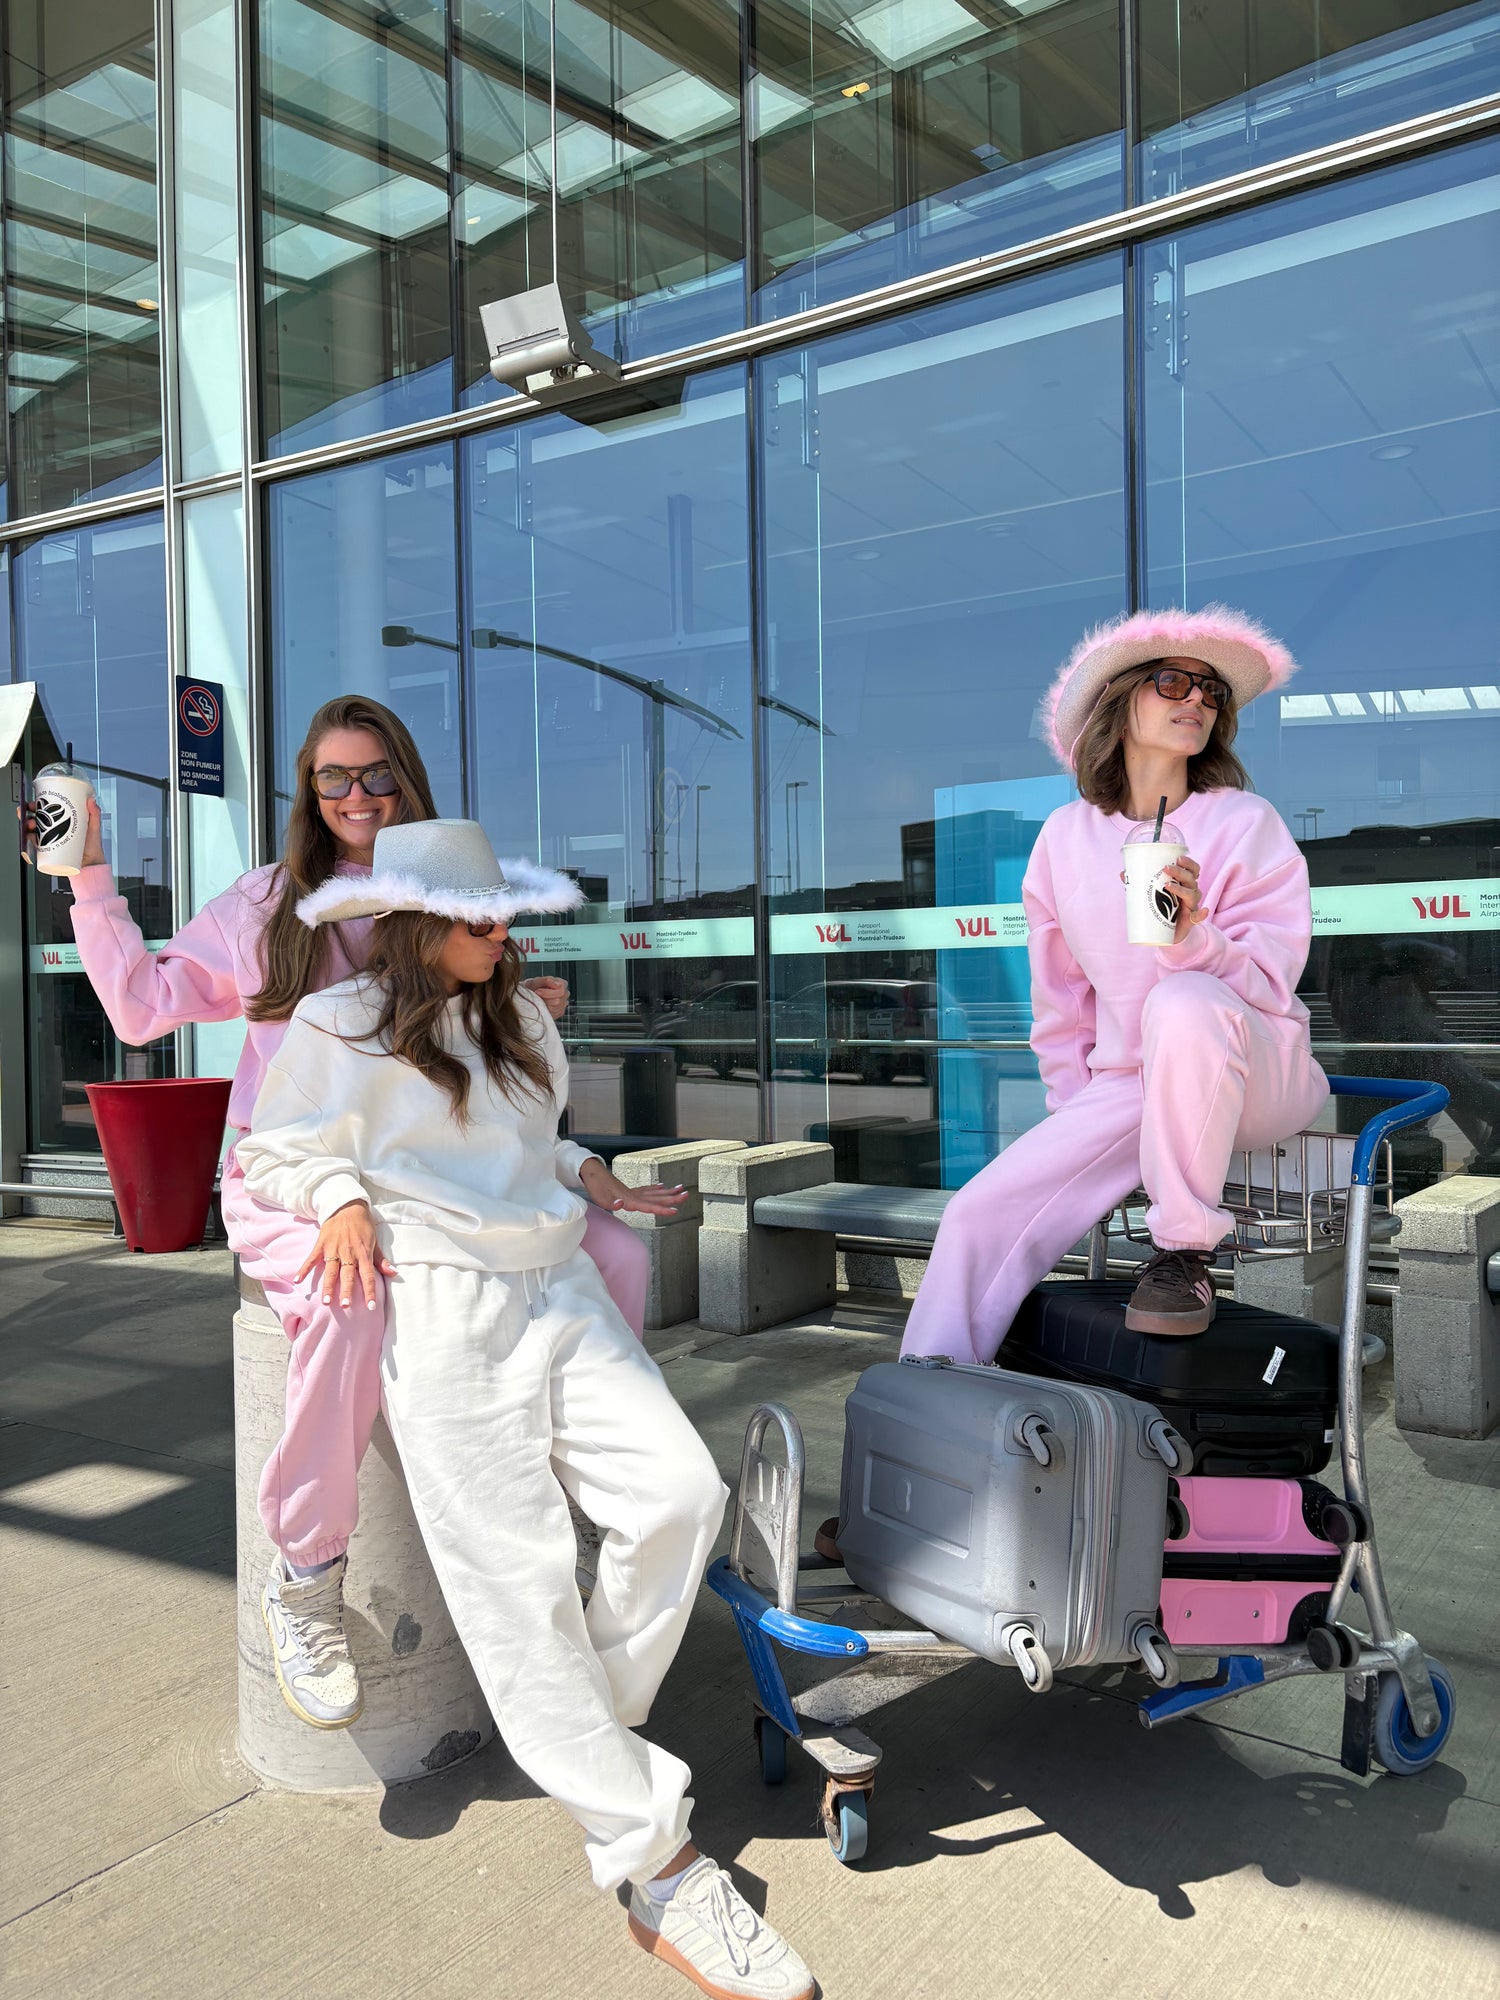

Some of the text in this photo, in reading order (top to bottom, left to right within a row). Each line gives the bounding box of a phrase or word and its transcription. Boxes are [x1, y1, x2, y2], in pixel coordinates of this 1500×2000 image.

[180, 750, 198, 760] ZONE
[180, 759, 221, 771] NON FUMEUR
[181, 770, 220, 782] NO SMOKING
[181, 778, 198, 787] AREA
[1411, 895, 1471, 919] YUL
[815, 923, 852, 943] YUL
[955, 917, 997, 937] YUL
[619, 932, 652, 950] YUL
[41, 951, 63, 965] YUL
